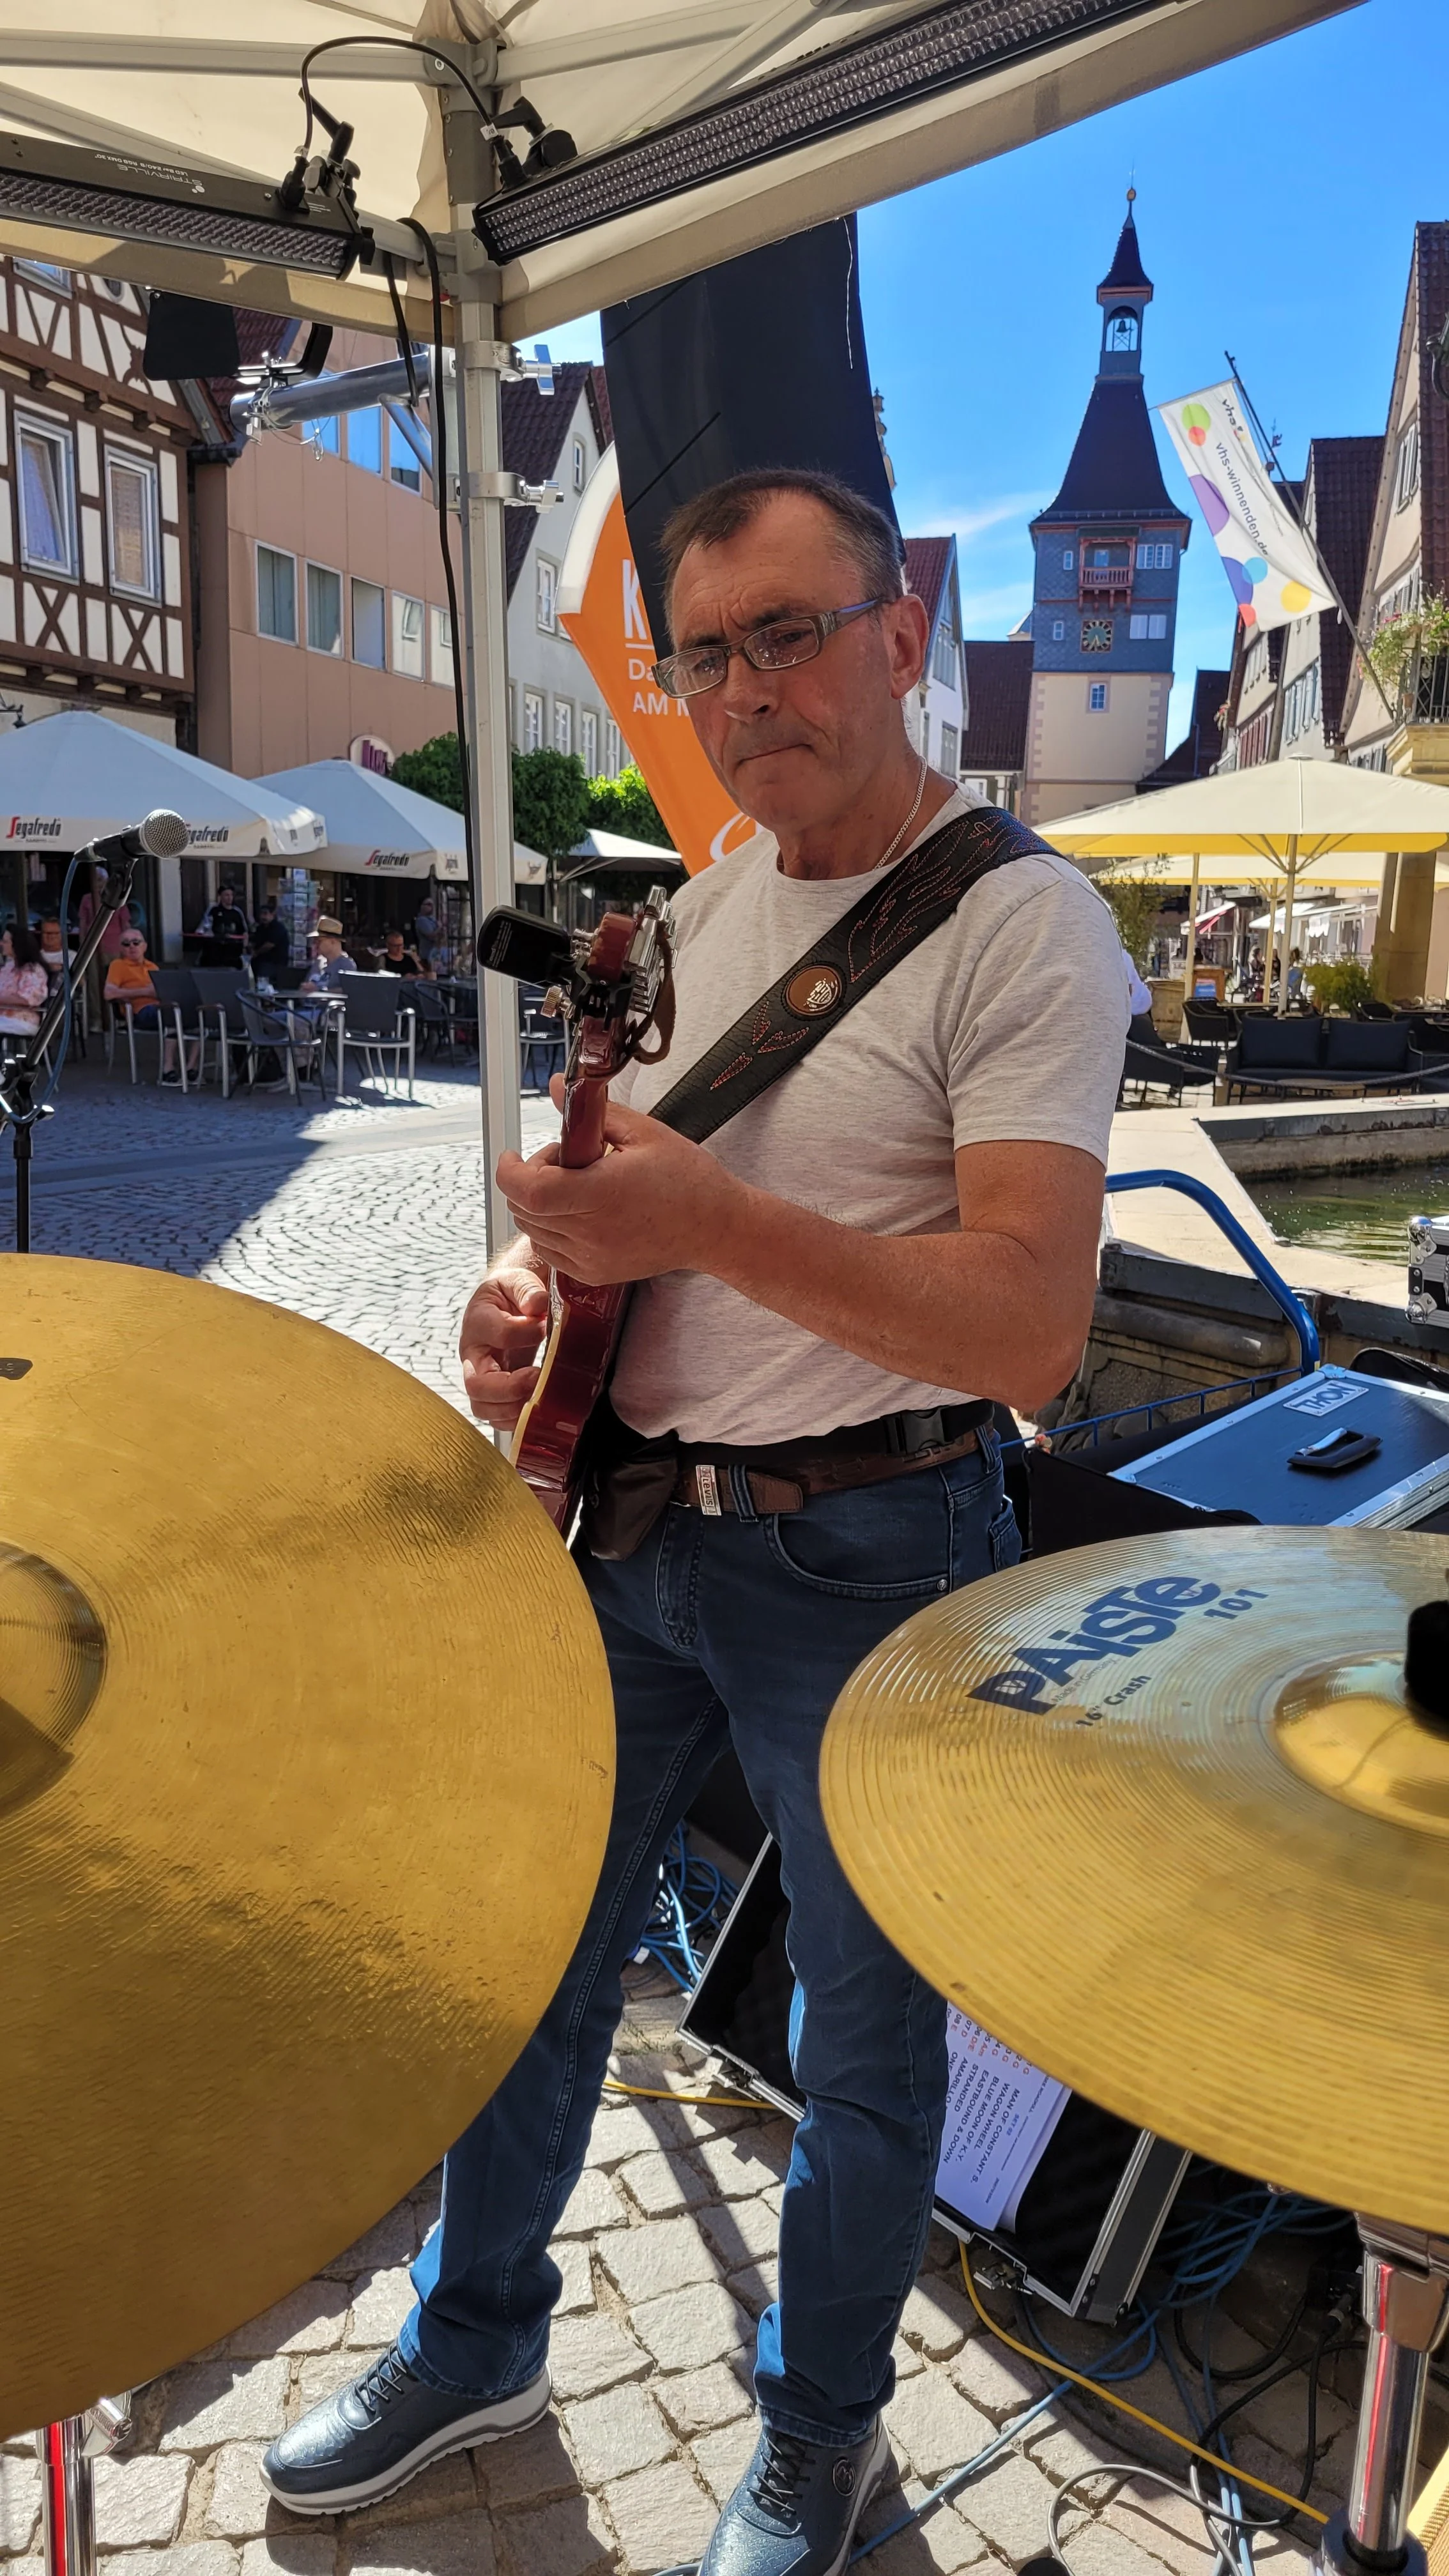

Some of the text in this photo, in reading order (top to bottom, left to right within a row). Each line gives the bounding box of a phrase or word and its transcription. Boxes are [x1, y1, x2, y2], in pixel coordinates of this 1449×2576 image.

[118, 164, 203, 186] STAIRVILLE
[1222, 399, 1236, 427] vhs
[1216, 442, 1268, 556] vhs-winnenden.de
[622, 559, 647, 641] K
[629, 658, 655, 682] Da
[633, 691, 668, 716] AM
[6, 816, 61, 839] Segafredo
[364, 849, 410, 867] Segafredo
[1292, 1383, 1356, 1409] THON
[1204, 1588, 1269, 1620] 101
[1103, 1675, 1153, 1706] Crash
[954, 2014, 962, 2024] 08
[965, 2020, 974, 2030] 07
[979, 2041, 988, 2057] Am
[946, 2058, 967, 2103] AMARILLO
[954, 2064, 978, 2112] STRANDED
[985, 2076, 999, 2101] BLUE
[962, 2070, 989, 2125] EASTBOUND
[990, 2083, 1010, 2118] WAGON
[1007, 2089, 1020, 2110] MAN
[972, 2101, 988, 2130] MOON
[1001, 2111, 1009, 2124] OF
[967, 2131, 974, 2144] OF
[974, 2119, 993, 2149] WHEEL
[944, 2134, 960, 2163] DOWN
[977, 2125, 1002, 2174] CONSTANT
